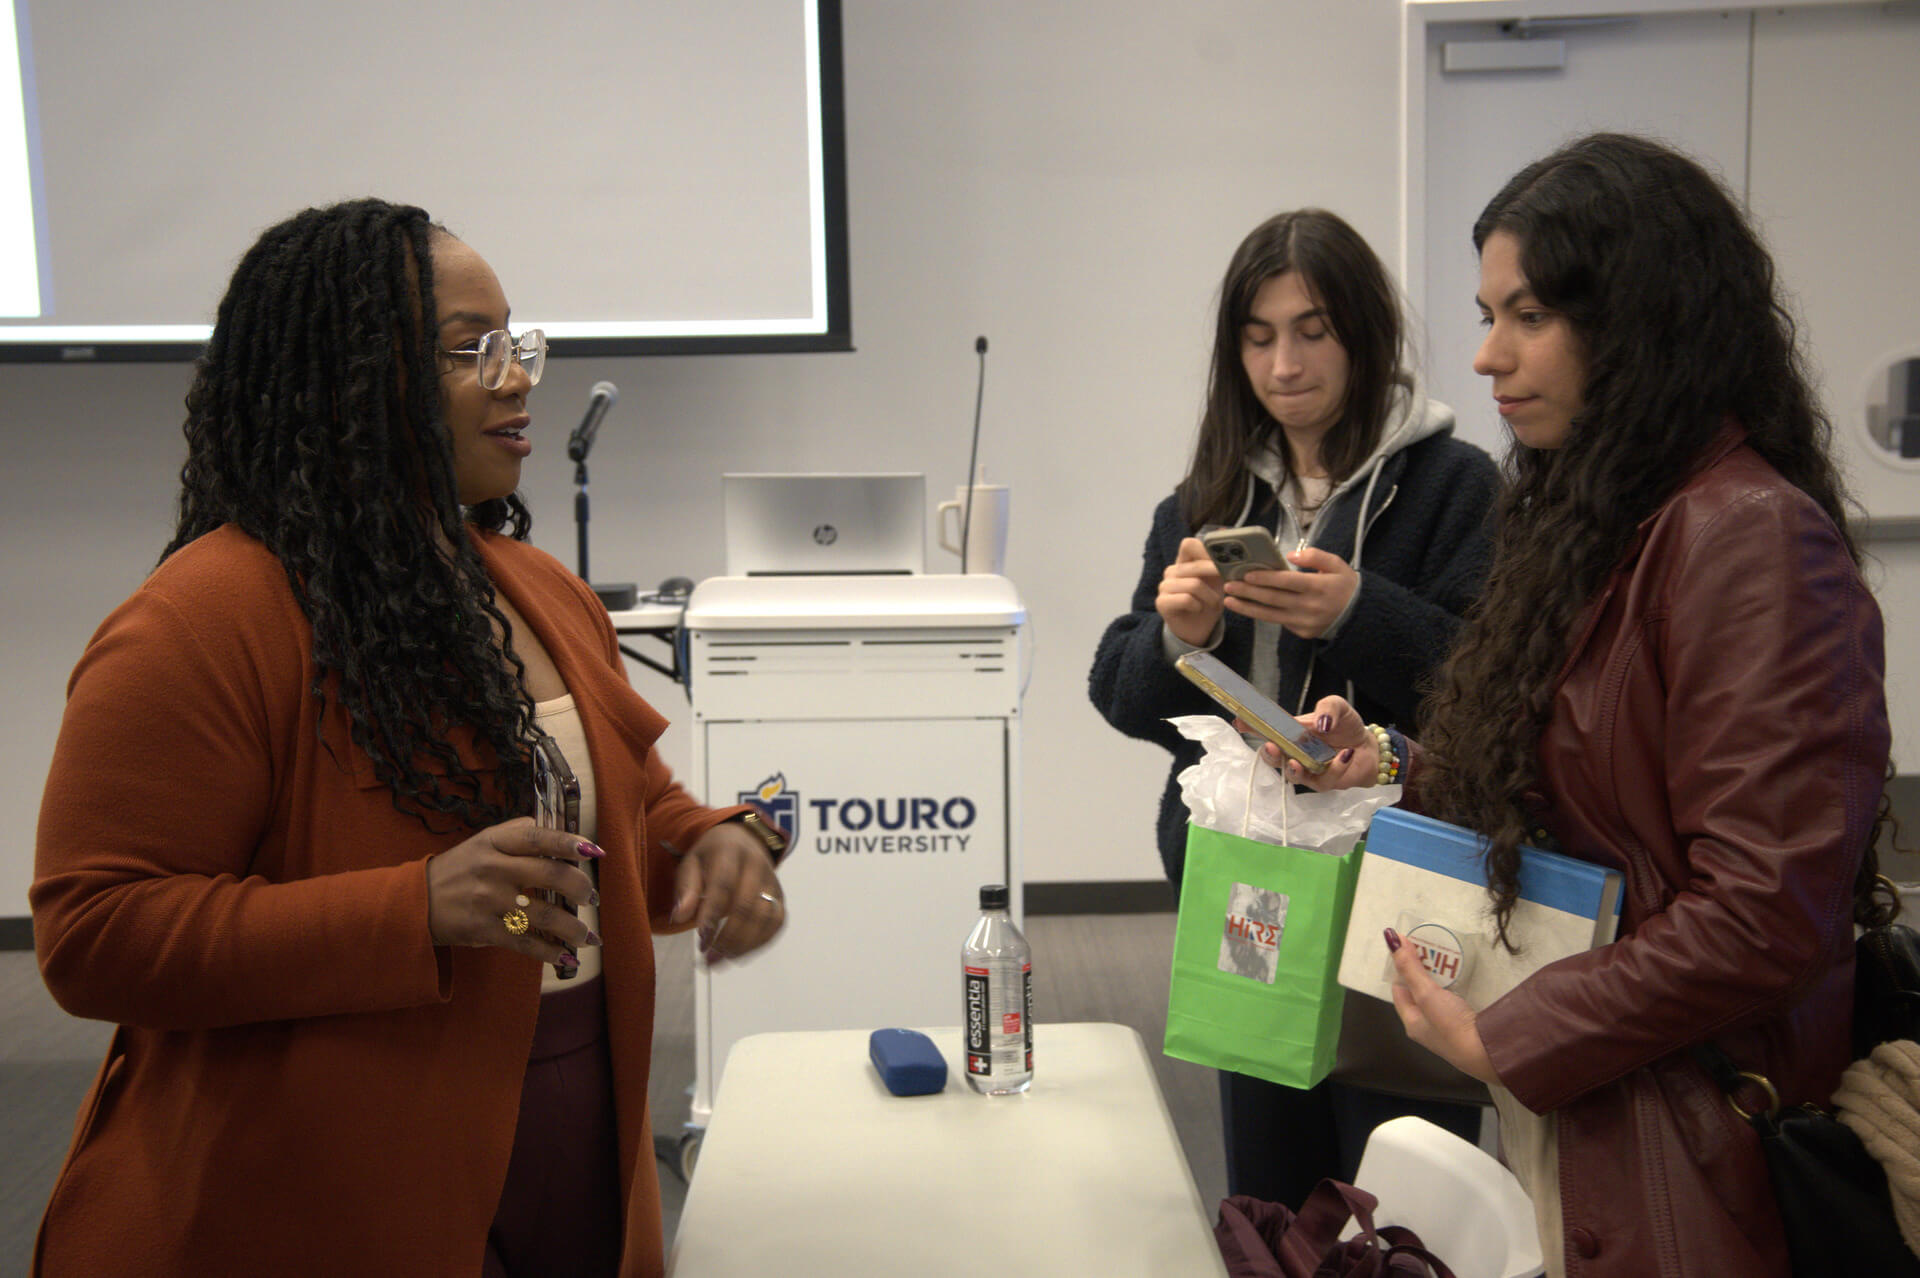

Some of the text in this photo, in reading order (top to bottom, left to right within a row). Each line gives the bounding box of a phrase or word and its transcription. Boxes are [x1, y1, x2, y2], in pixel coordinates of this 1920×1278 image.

[810, 797, 976, 831] TOURO
[816, 835, 971, 854] UNIVERSITY
[967, 979, 982, 1049] essentia
